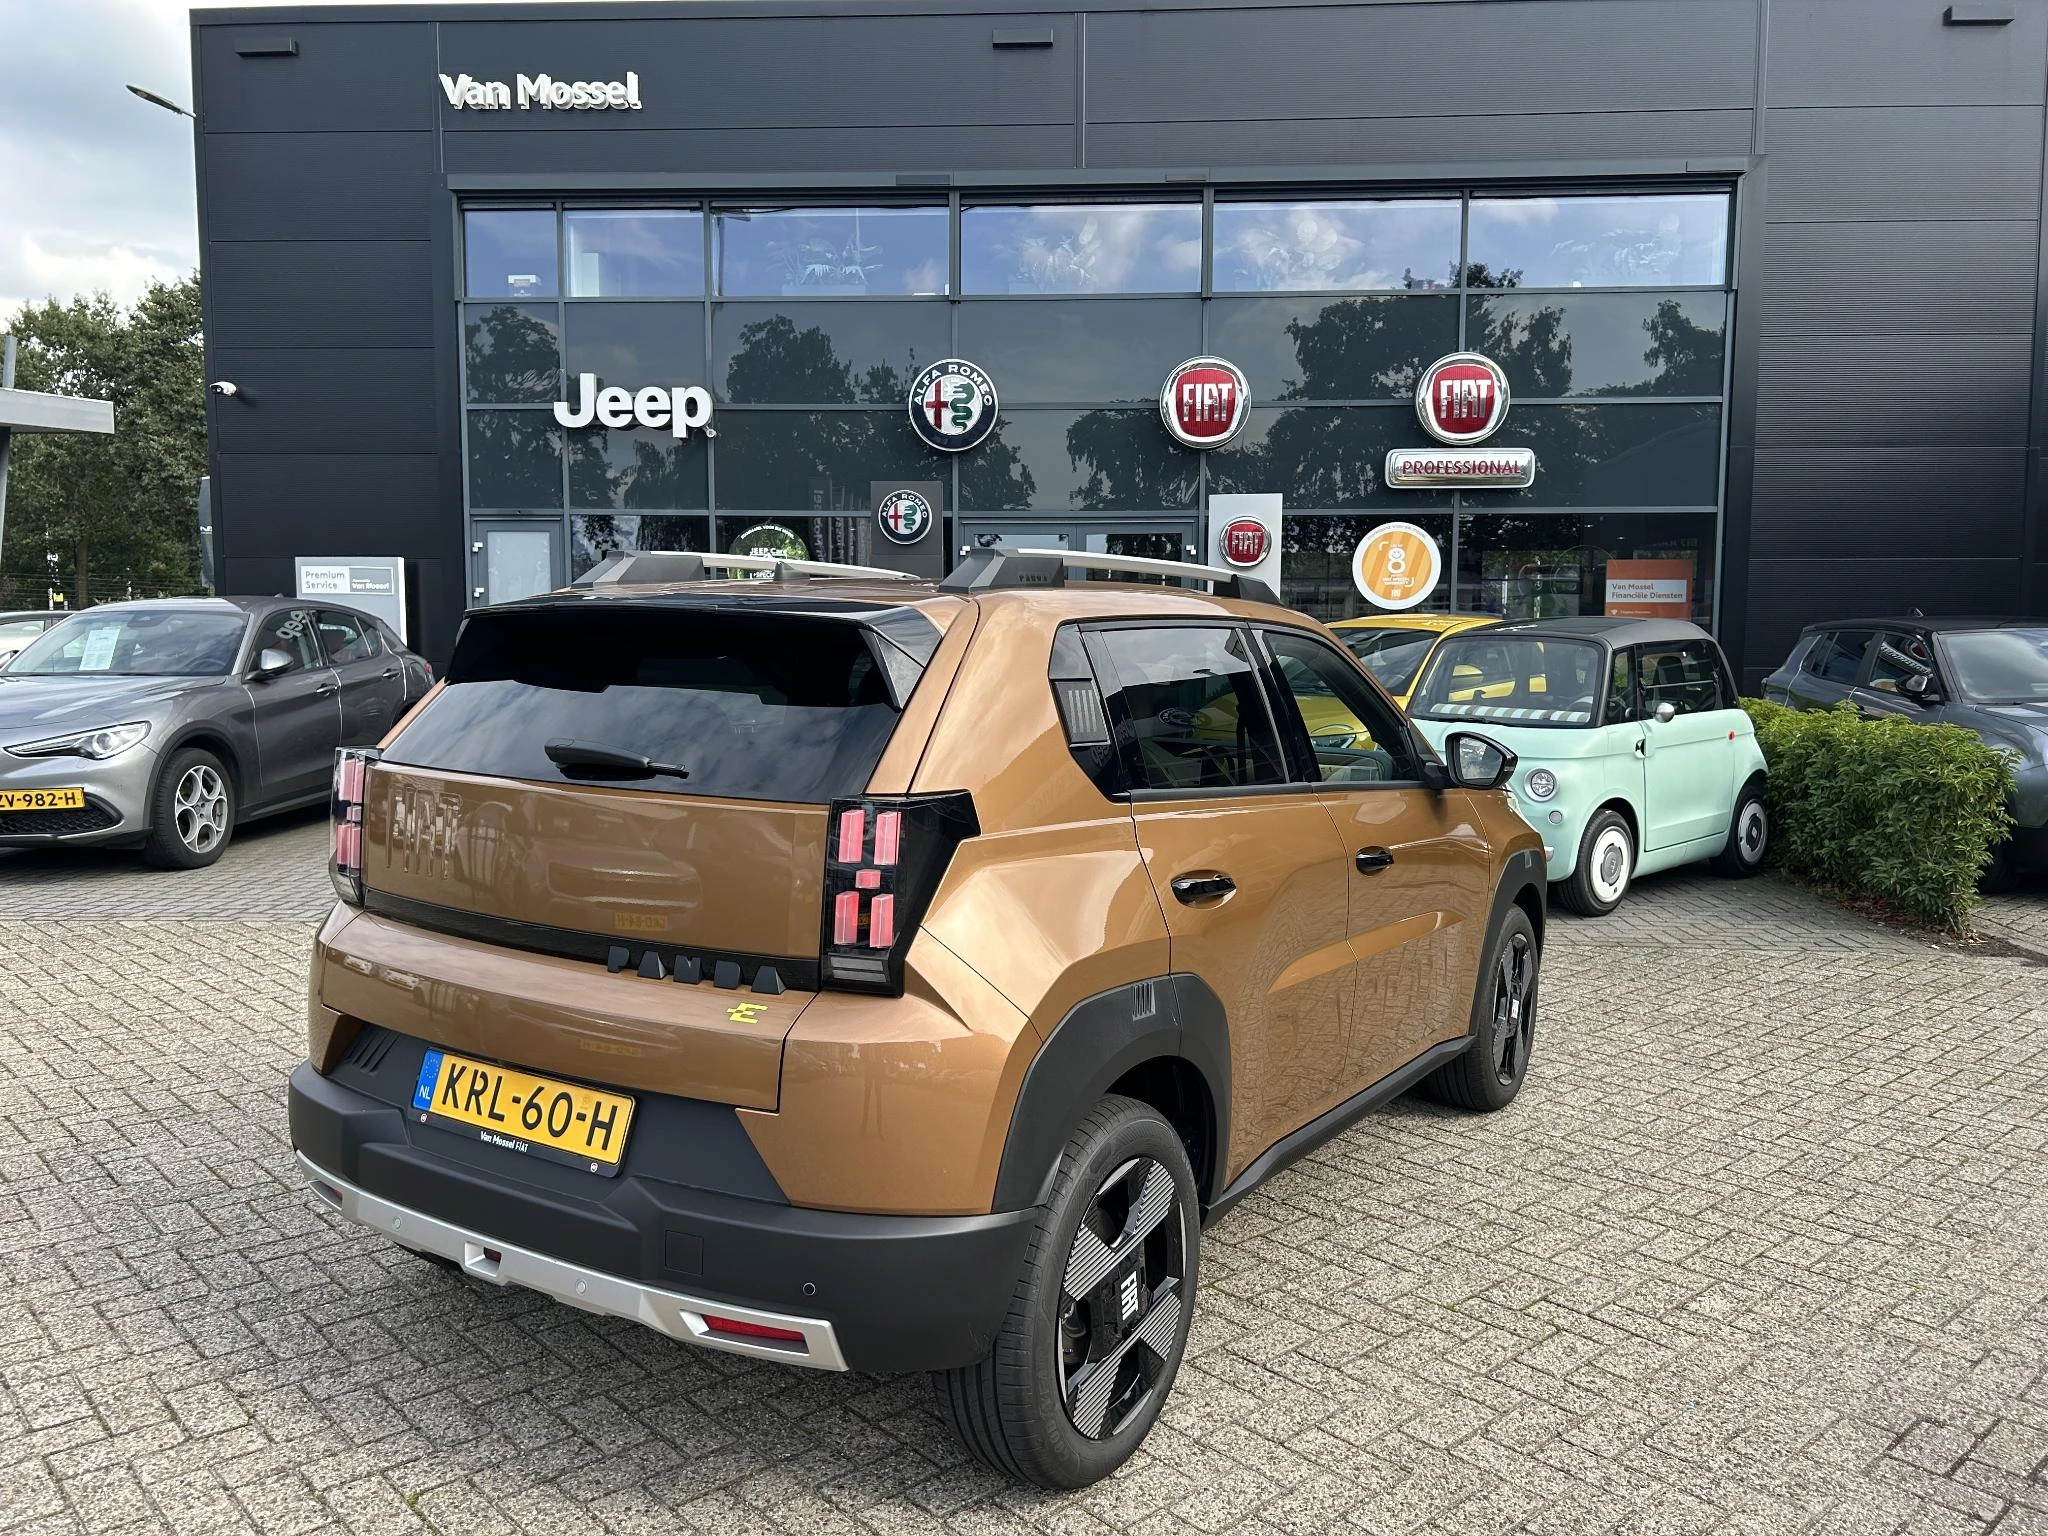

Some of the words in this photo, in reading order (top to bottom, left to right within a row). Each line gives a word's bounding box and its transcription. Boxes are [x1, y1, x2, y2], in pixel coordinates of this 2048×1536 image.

[439, 73, 511, 110] Van
[516, 71, 642, 110] Mossel
[914, 369, 941, 405] ALFA
[948, 364, 993, 406] ROMEO
[1440, 379, 1491, 418] FIAT
[553, 373, 713, 438] Jeep
[1183, 383, 1232, 422] FIAT
[1402, 460, 1521, 475] PROFESSIONAL
[881, 496, 898, 518] ALFA
[901, 493, 928, 518] ROMEO
[750, 547, 769, 555] JEEP
[1232, 531, 1262, 555] FIAT
[305, 571, 345, 579] Premium
[305, 581, 338, 590] Service
[1612, 591, 1648, 599] Financiële
[1650, 591, 1683, 599] Diensten
[387, 784, 463, 880] FIAT
[607, 945, 787, 995] PANDA
[418, 1084, 431, 1101] NL
[442, 1063, 617, 1151] KRL-60-H
[480, 1131, 492, 1143] Van
[492, 1134, 516, 1149] Mossel
[515, 1141, 529, 1152] FIAT
[1121, 1271, 1138, 1320] FIAT
